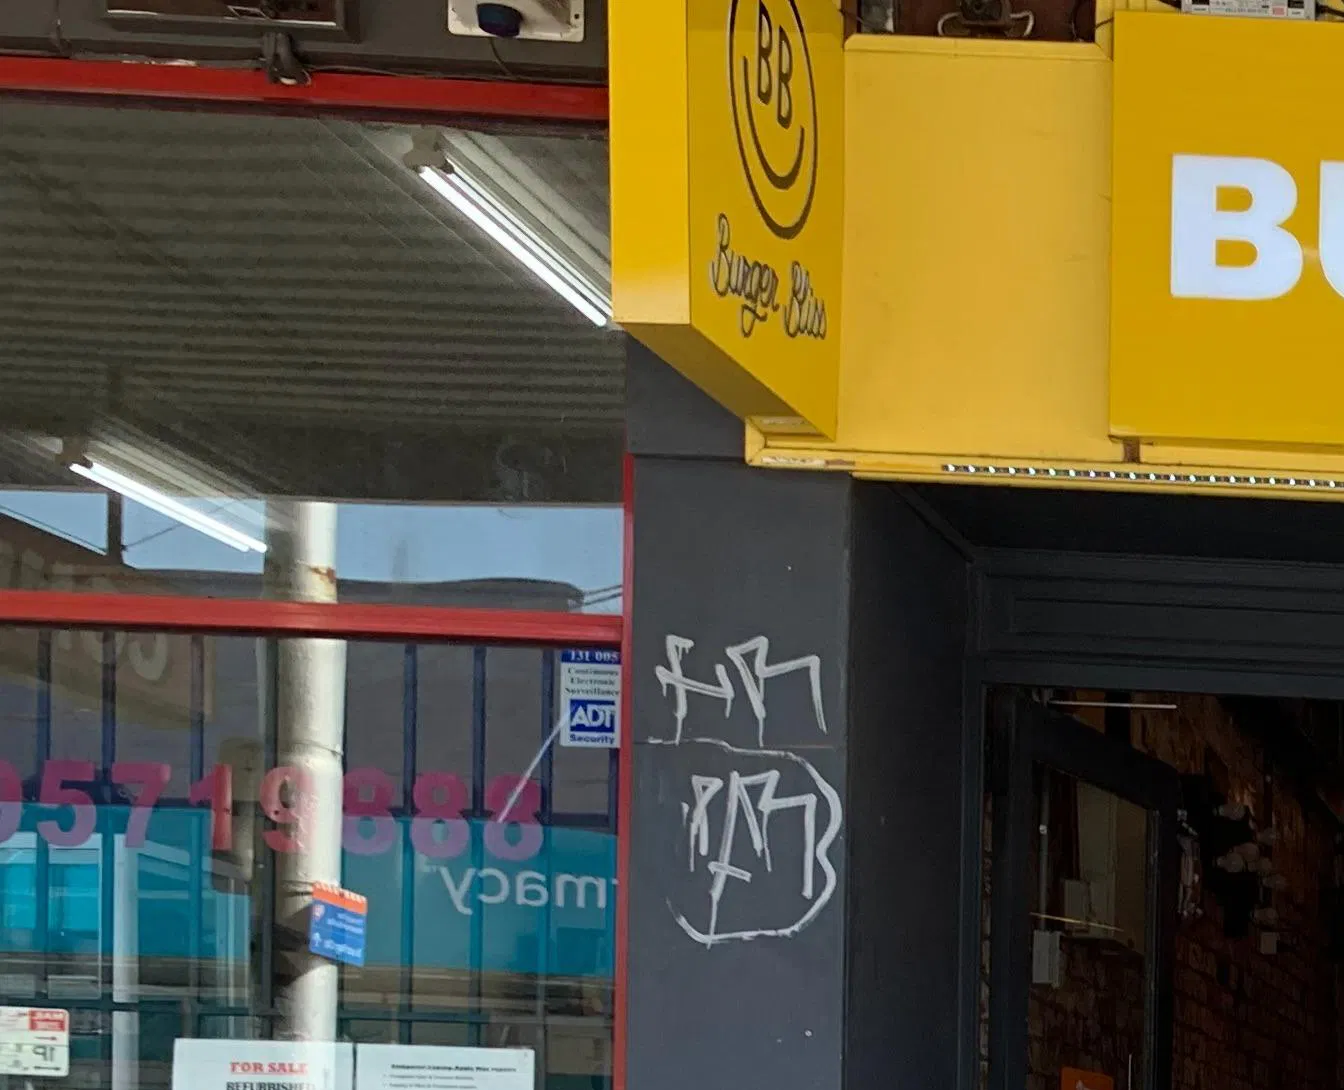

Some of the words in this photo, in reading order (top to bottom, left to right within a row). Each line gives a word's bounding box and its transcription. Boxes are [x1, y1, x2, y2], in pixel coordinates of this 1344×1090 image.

[757, 0, 792, 129] BB
[711, 212, 780, 338] Burger
[784, 260, 827, 340] Bliss
[571, 650, 590, 661] 131
[571, 704, 615, 728] ADT
[570, 734, 615, 744] Security
[230, 1062, 264, 1074] FOR
[269, 1062, 308, 1074] SALE
